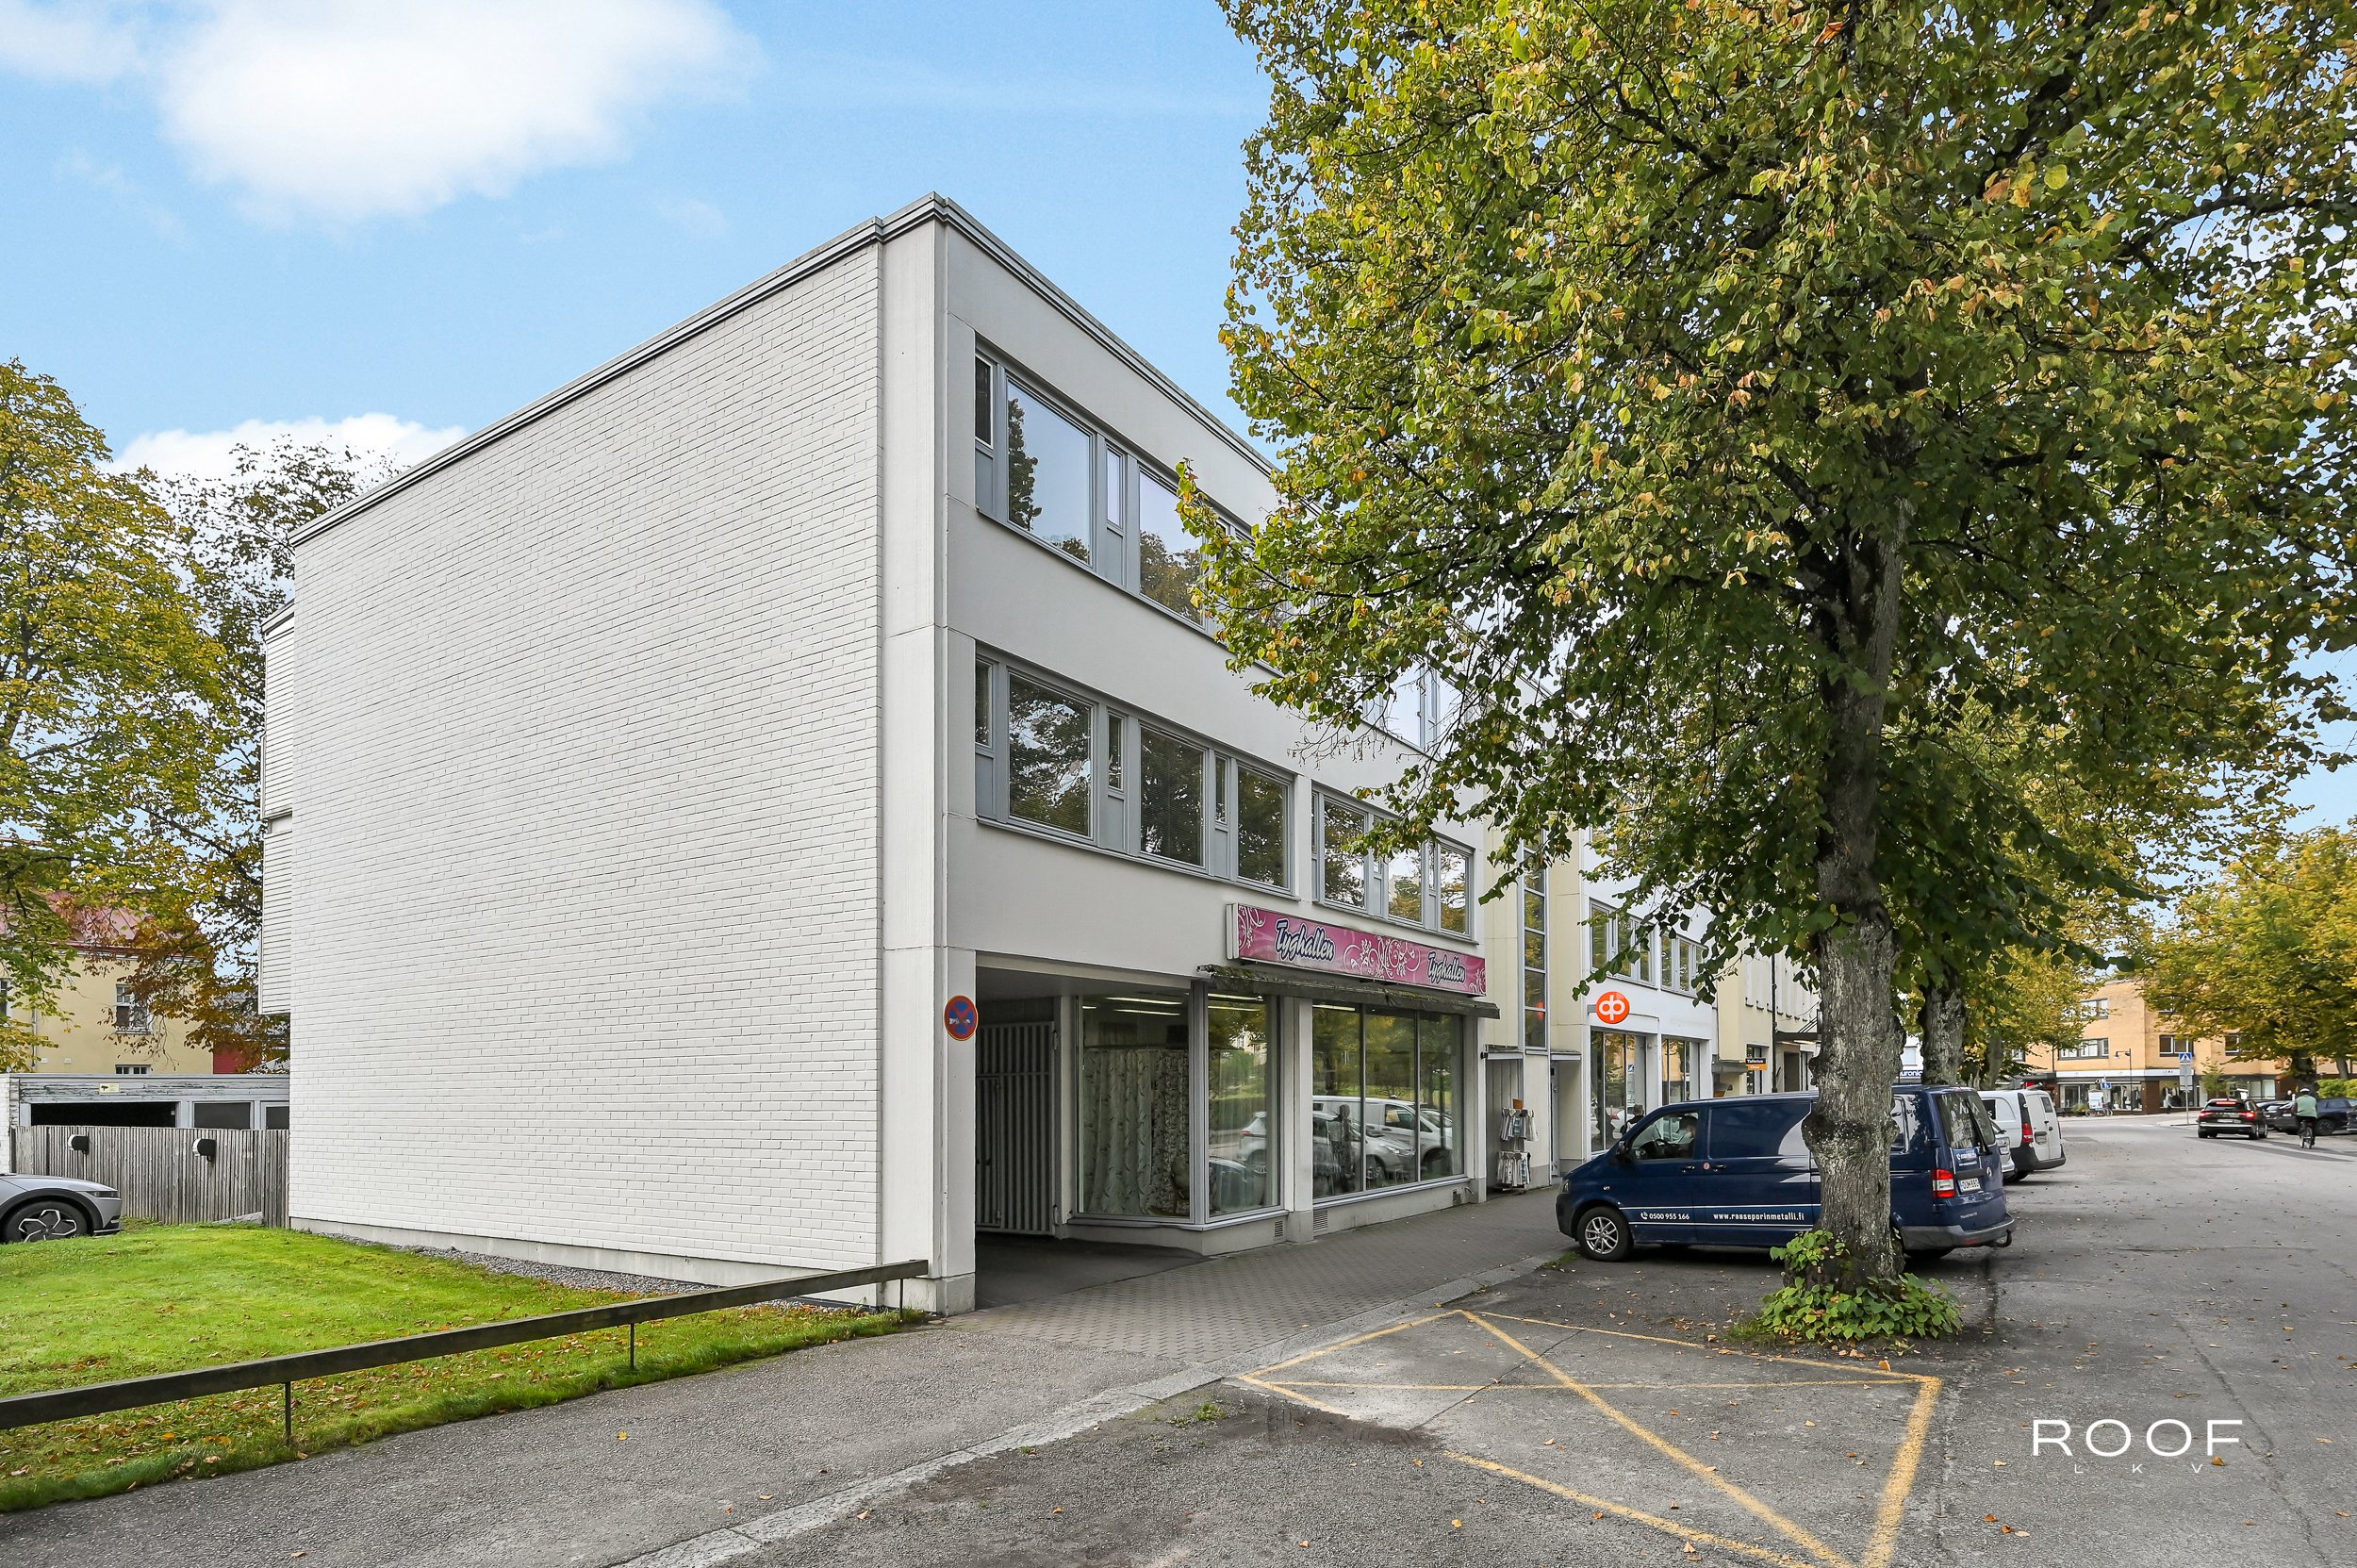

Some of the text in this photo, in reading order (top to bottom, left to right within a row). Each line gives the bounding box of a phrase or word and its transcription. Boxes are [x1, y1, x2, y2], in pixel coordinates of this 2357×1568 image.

[1276, 918, 1335, 962] Tyghallen
[1427, 951, 1466, 984] Tyghallen
[1713, 1212, 1805, 1222] www.raaseporinmetalli.fi
